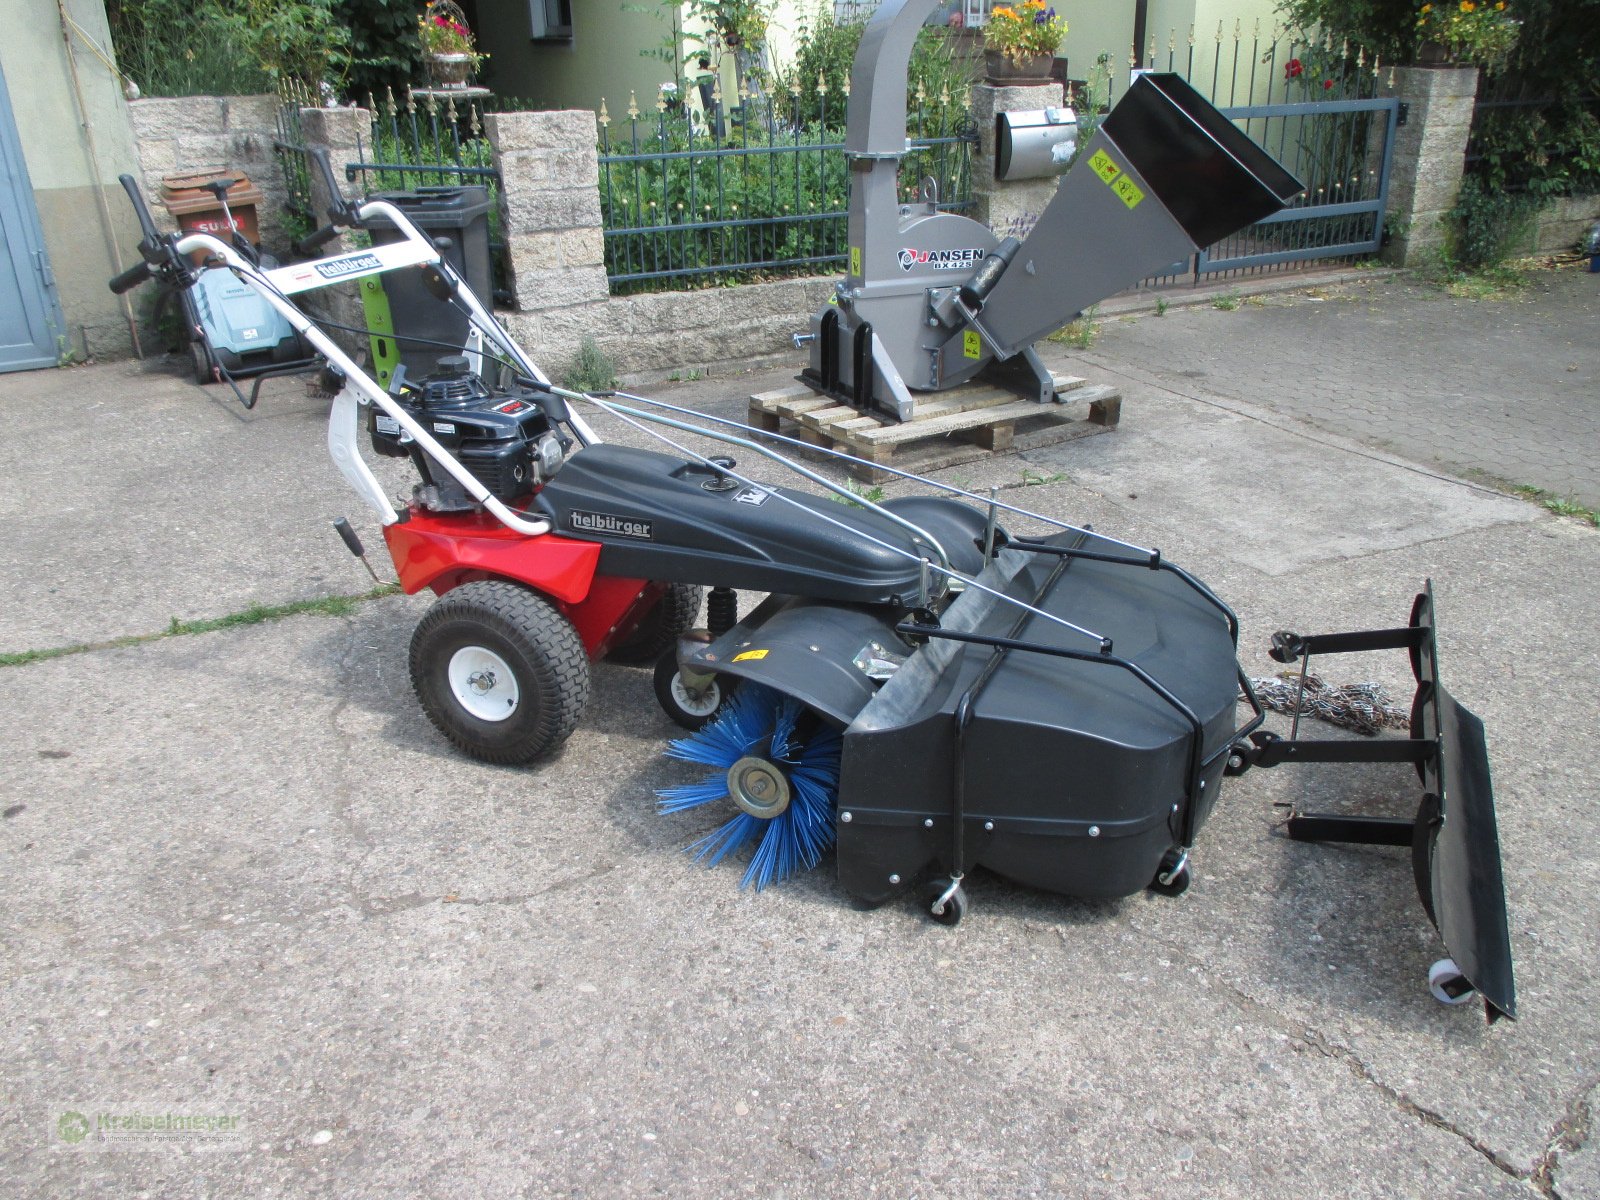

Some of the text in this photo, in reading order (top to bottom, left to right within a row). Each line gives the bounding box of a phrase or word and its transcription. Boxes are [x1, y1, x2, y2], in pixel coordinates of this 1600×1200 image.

[318, 255, 380, 276] tielbürger
[918, 248, 984, 263] JANSEN
[571, 511, 651, 537] tielbürger
